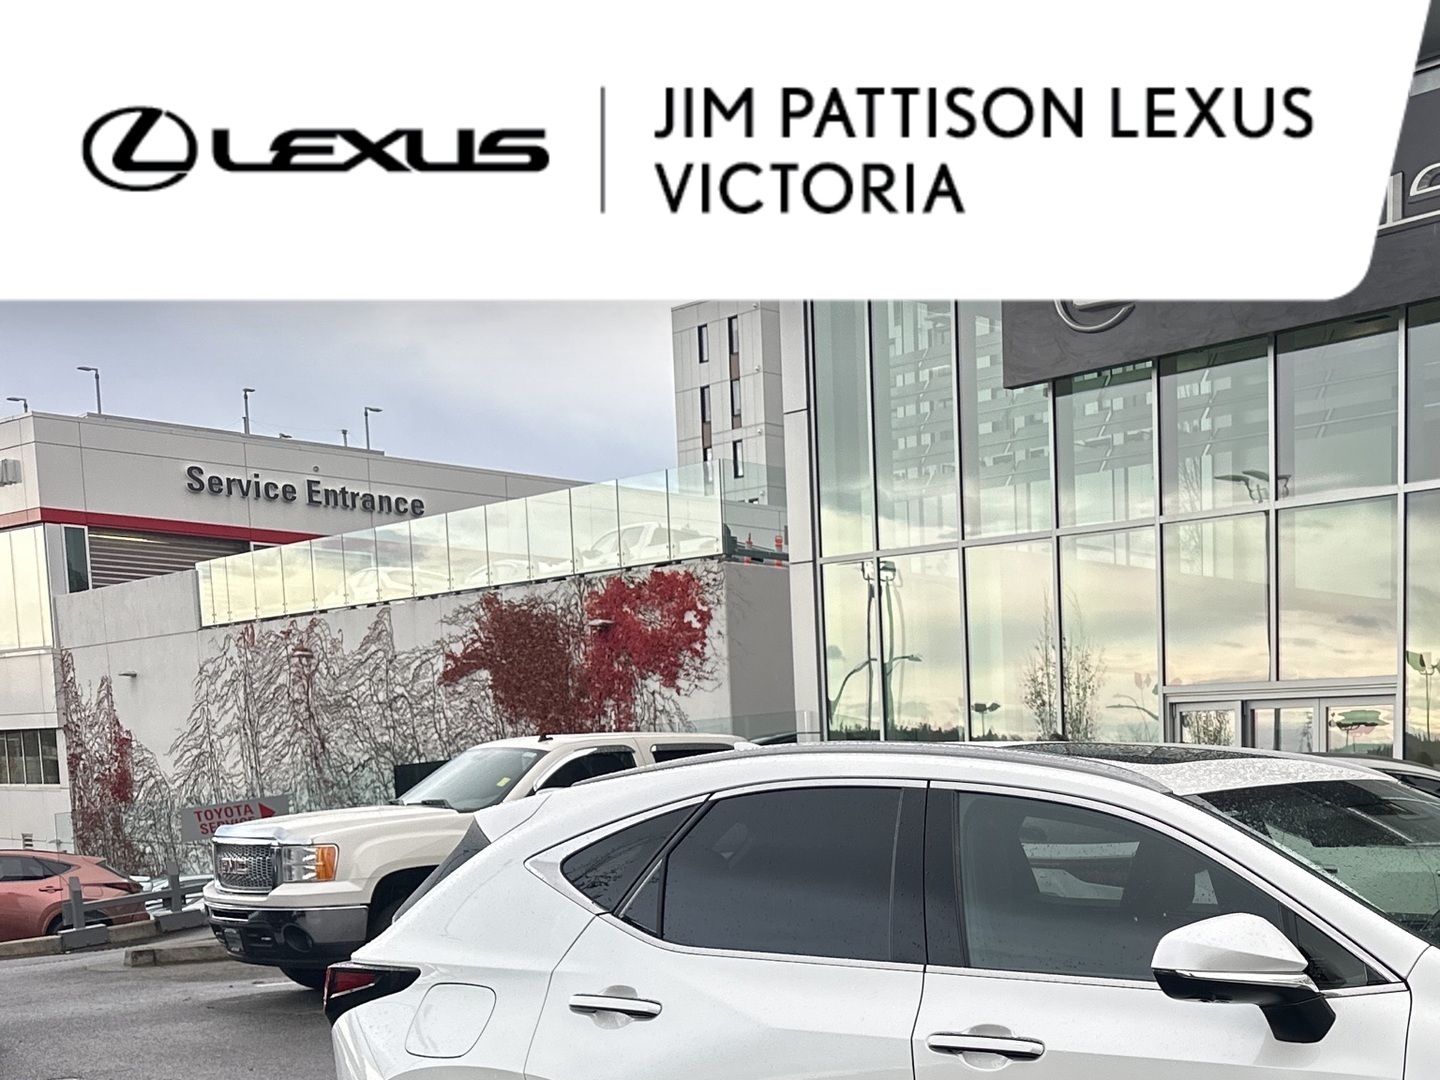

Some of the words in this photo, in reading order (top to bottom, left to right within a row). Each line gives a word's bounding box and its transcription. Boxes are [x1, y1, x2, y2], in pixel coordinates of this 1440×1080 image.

[186, 465, 297, 502] Service
[306, 478, 425, 516] Entrance
[193, 804, 254, 822] TOYOTA
